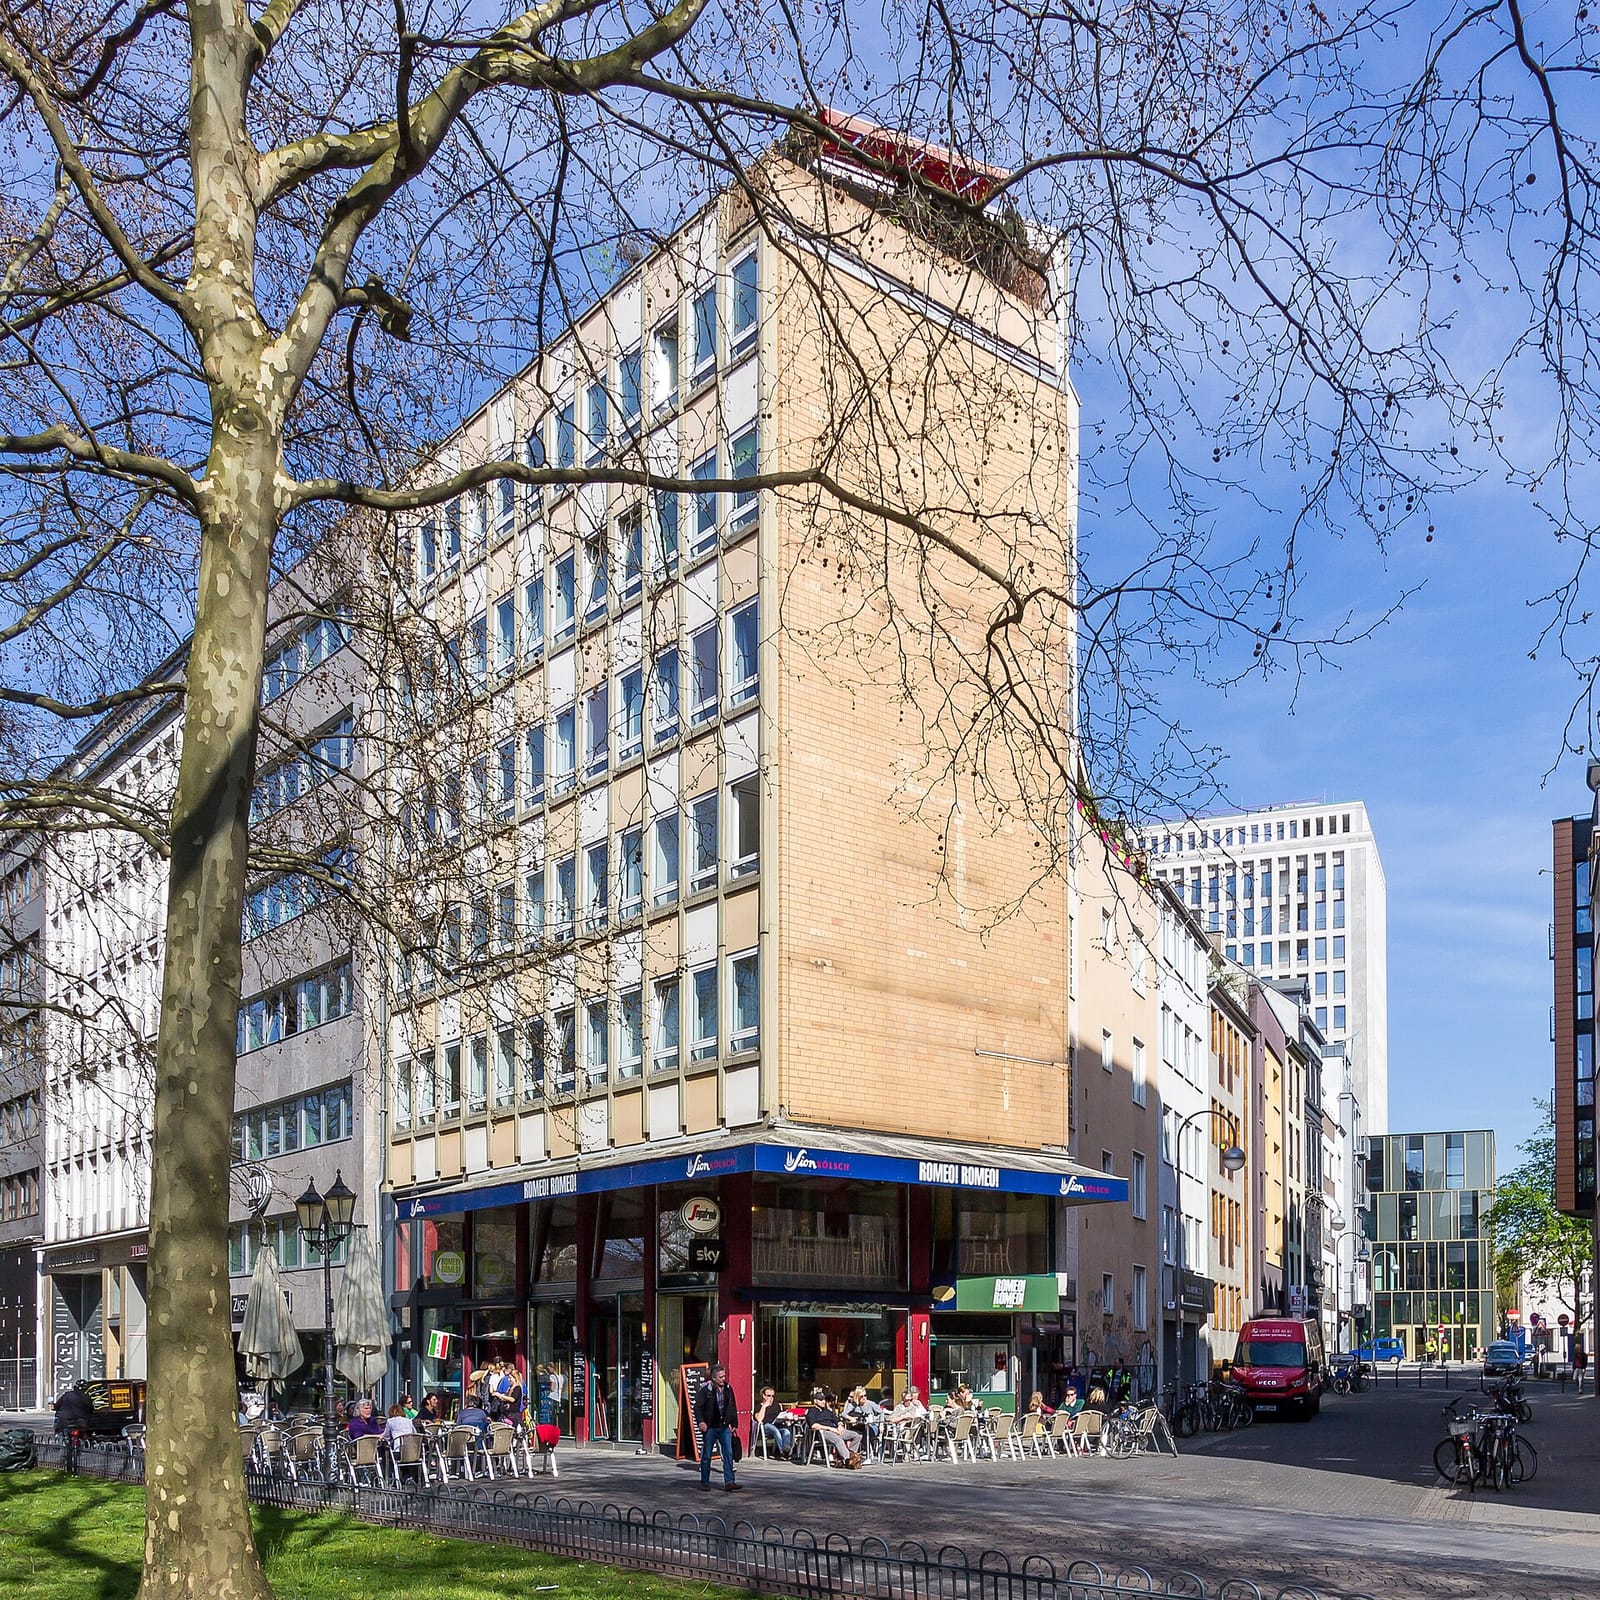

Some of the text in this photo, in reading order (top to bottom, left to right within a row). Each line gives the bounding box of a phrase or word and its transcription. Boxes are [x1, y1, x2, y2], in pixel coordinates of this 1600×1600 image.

[686, 1154, 710, 1177] Sion
[784, 1149, 849, 1171] Sion KÖLSCH
[919, 1161, 1000, 1188] ROMEO! ROMEO!
[524, 1173, 577, 1200] ROMEO! ROMEO!
[1059, 1176, 1085, 1195] Sion
[696, 1246, 720, 1265] sky
[995, 1279, 1026, 1292] ROMEO!
[993, 1292, 1024, 1305] ROMEO!
